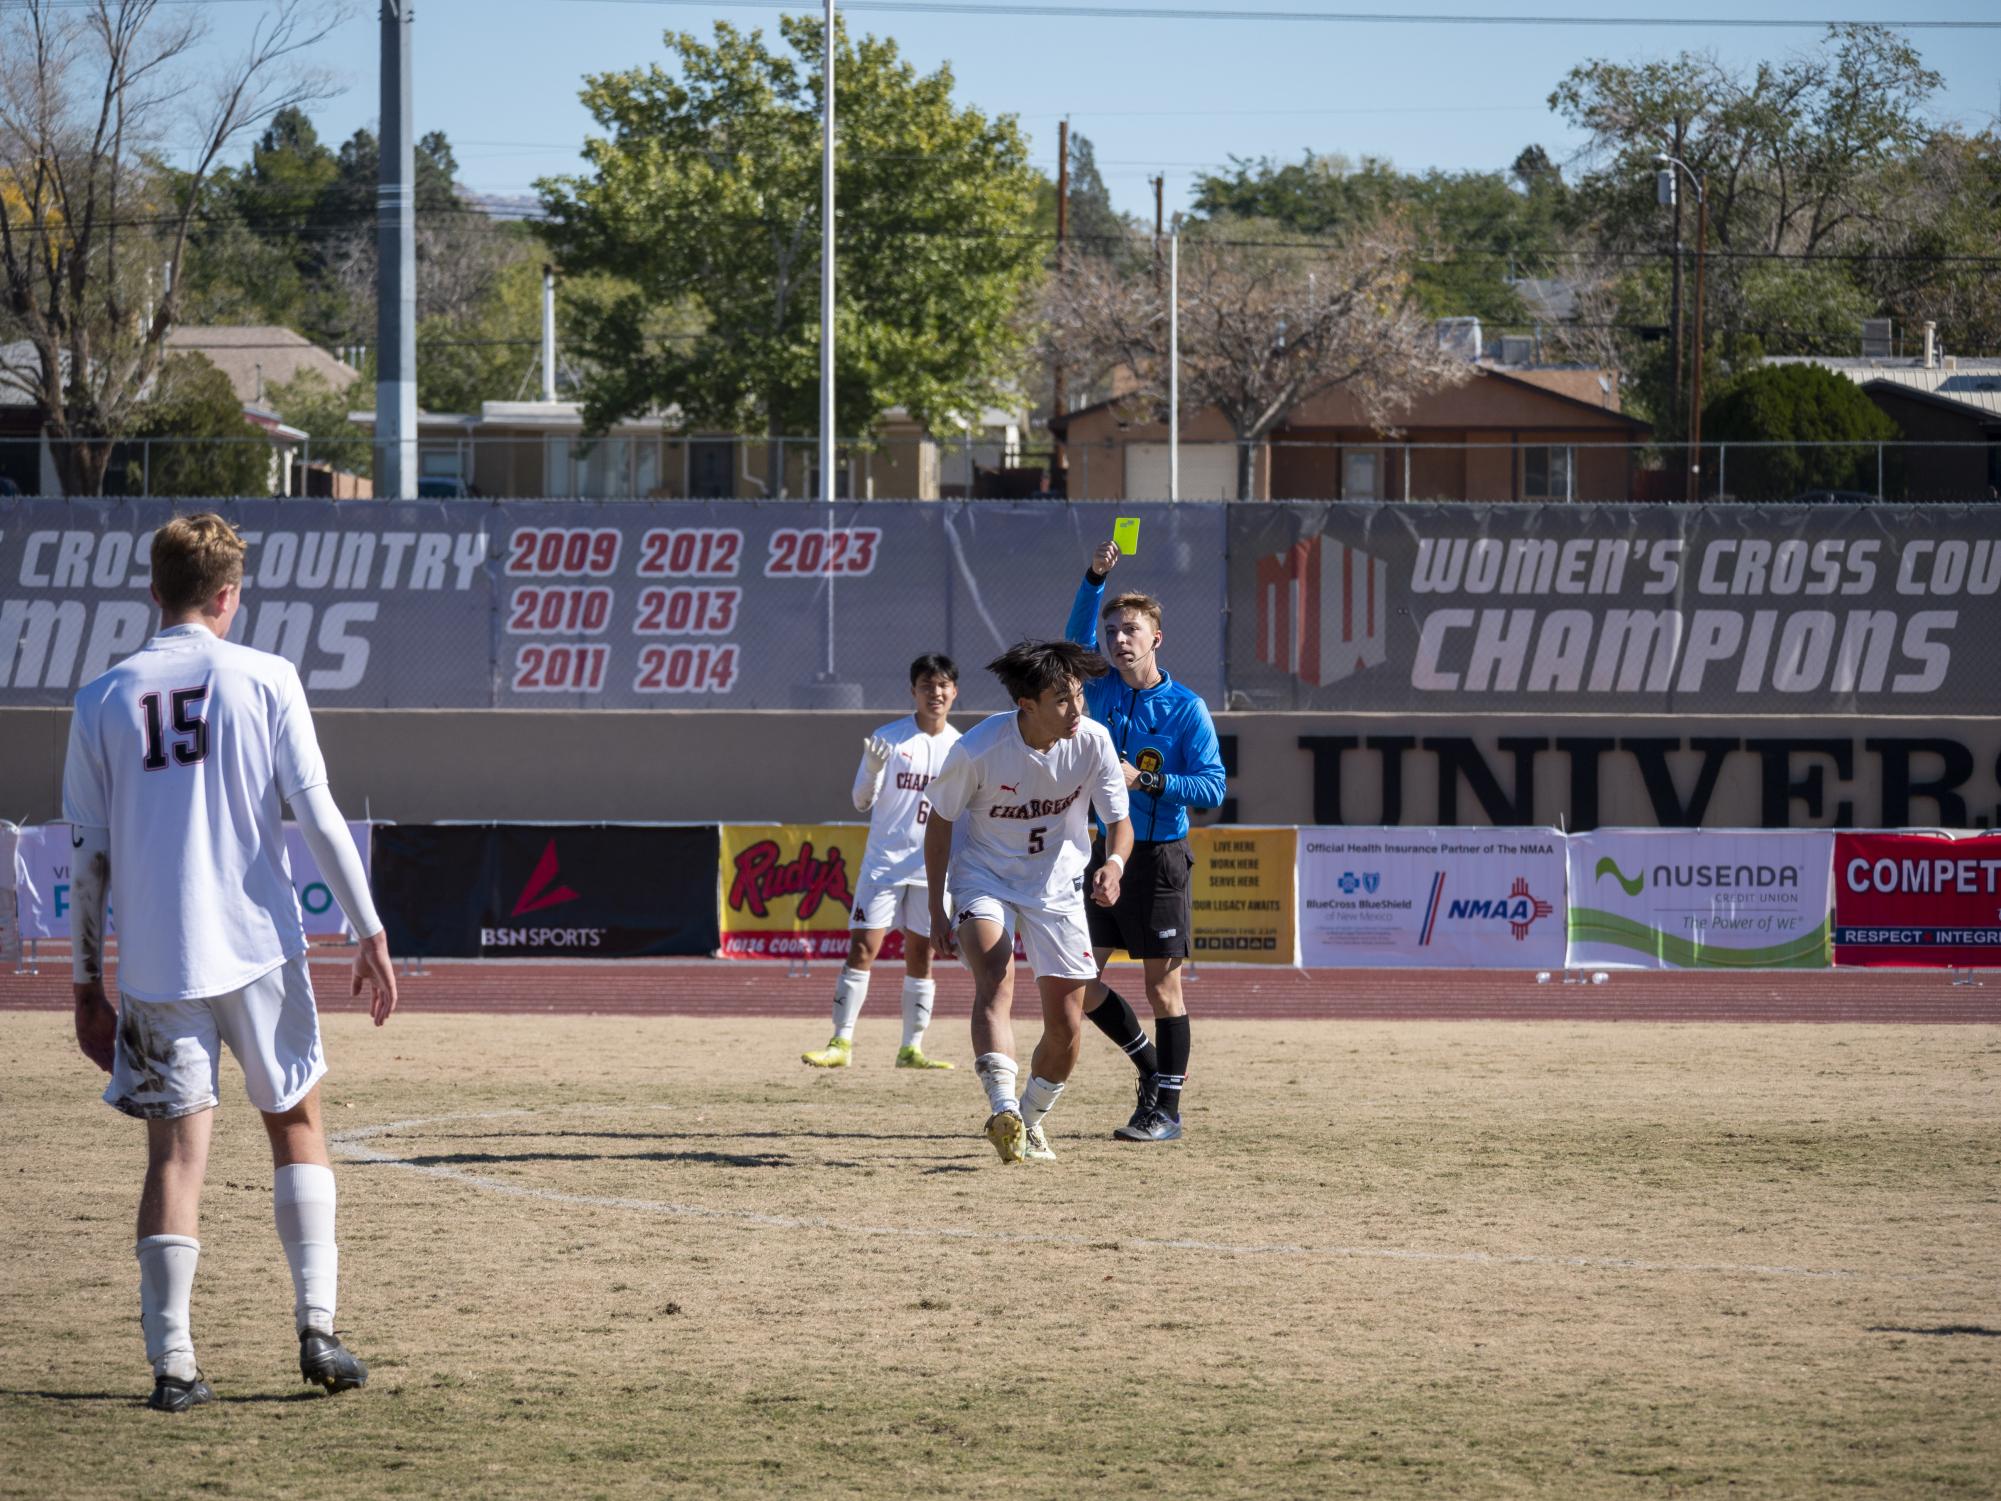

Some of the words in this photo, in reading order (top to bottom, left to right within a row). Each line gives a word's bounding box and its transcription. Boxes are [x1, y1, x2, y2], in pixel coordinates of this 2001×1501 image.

[20, 531, 153, 588] CRO
[505, 527, 621, 577] 2009
[637, 528, 744, 577] 2012
[765, 528, 882, 577] 2023
[1410, 538, 1685, 595] WOMEN'S
[1698, 539, 1881, 595] CROSS
[1896, 539, 2001, 595] COU
[506, 586, 614, 635] 2010
[633, 586, 741, 635] 2013
[0, 600, 379, 690] MPNS
[1411, 609, 1958, 693] CHAMPIONS
[512, 643, 610, 693] 2011
[634, 643, 739, 693] 2014
[139, 685, 210, 772] 15
[896, 772, 937, 792] CHAR
[1298, 736, 2001, 832] UNIVER
[917, 800, 929, 824] 6
[1028, 826, 1047, 855] 5
[1213, 840, 1231, 853] LIVE
[1233, 840, 1255, 853] HERE
[1306, 843, 1345, 854] Official
[1348, 843, 1382, 854] Health
[1384, 843, 1438, 854] Insurance
[1441, 844, 1480, 854] Partner
[1483, 844, 1494, 855] of
[1497, 844, 1517, 855] The
[1520, 844, 1554, 855] NMAA
[729, 840, 854, 920] Rudy's
[1210, 859, 1235, 870] WORK
[1237, 859, 1258, 870] HERE
[1653, 866, 1798, 887] NUSENDA
[1846, 858, 2001, 894] COMPET
[1209, 876, 1235, 888] SERVE
[1237, 876, 1259, 888] HERE
[1715, 893, 1755, 903] CREDIT
[1759, 893, 1798, 903] UNION
[1213, 900, 1246, 912] LEGACY
[1248, 900, 1280, 912] AWAITS
[1306, 900, 1357, 910] BlueCross
[1358, 899, 1412, 910] BlueShield
[1338, 913, 1362, 922] New
[1363, 913, 1393, 922] Mexico
[1448, 899, 1529, 919] NMAA
[1682, 916, 1708, 929] The
[1712, 916, 1756, 929] Power
[1759, 915, 1774, 932] of
[1776, 917, 1798, 930] WE
[1845, 931, 1923, 943] RESPECT
